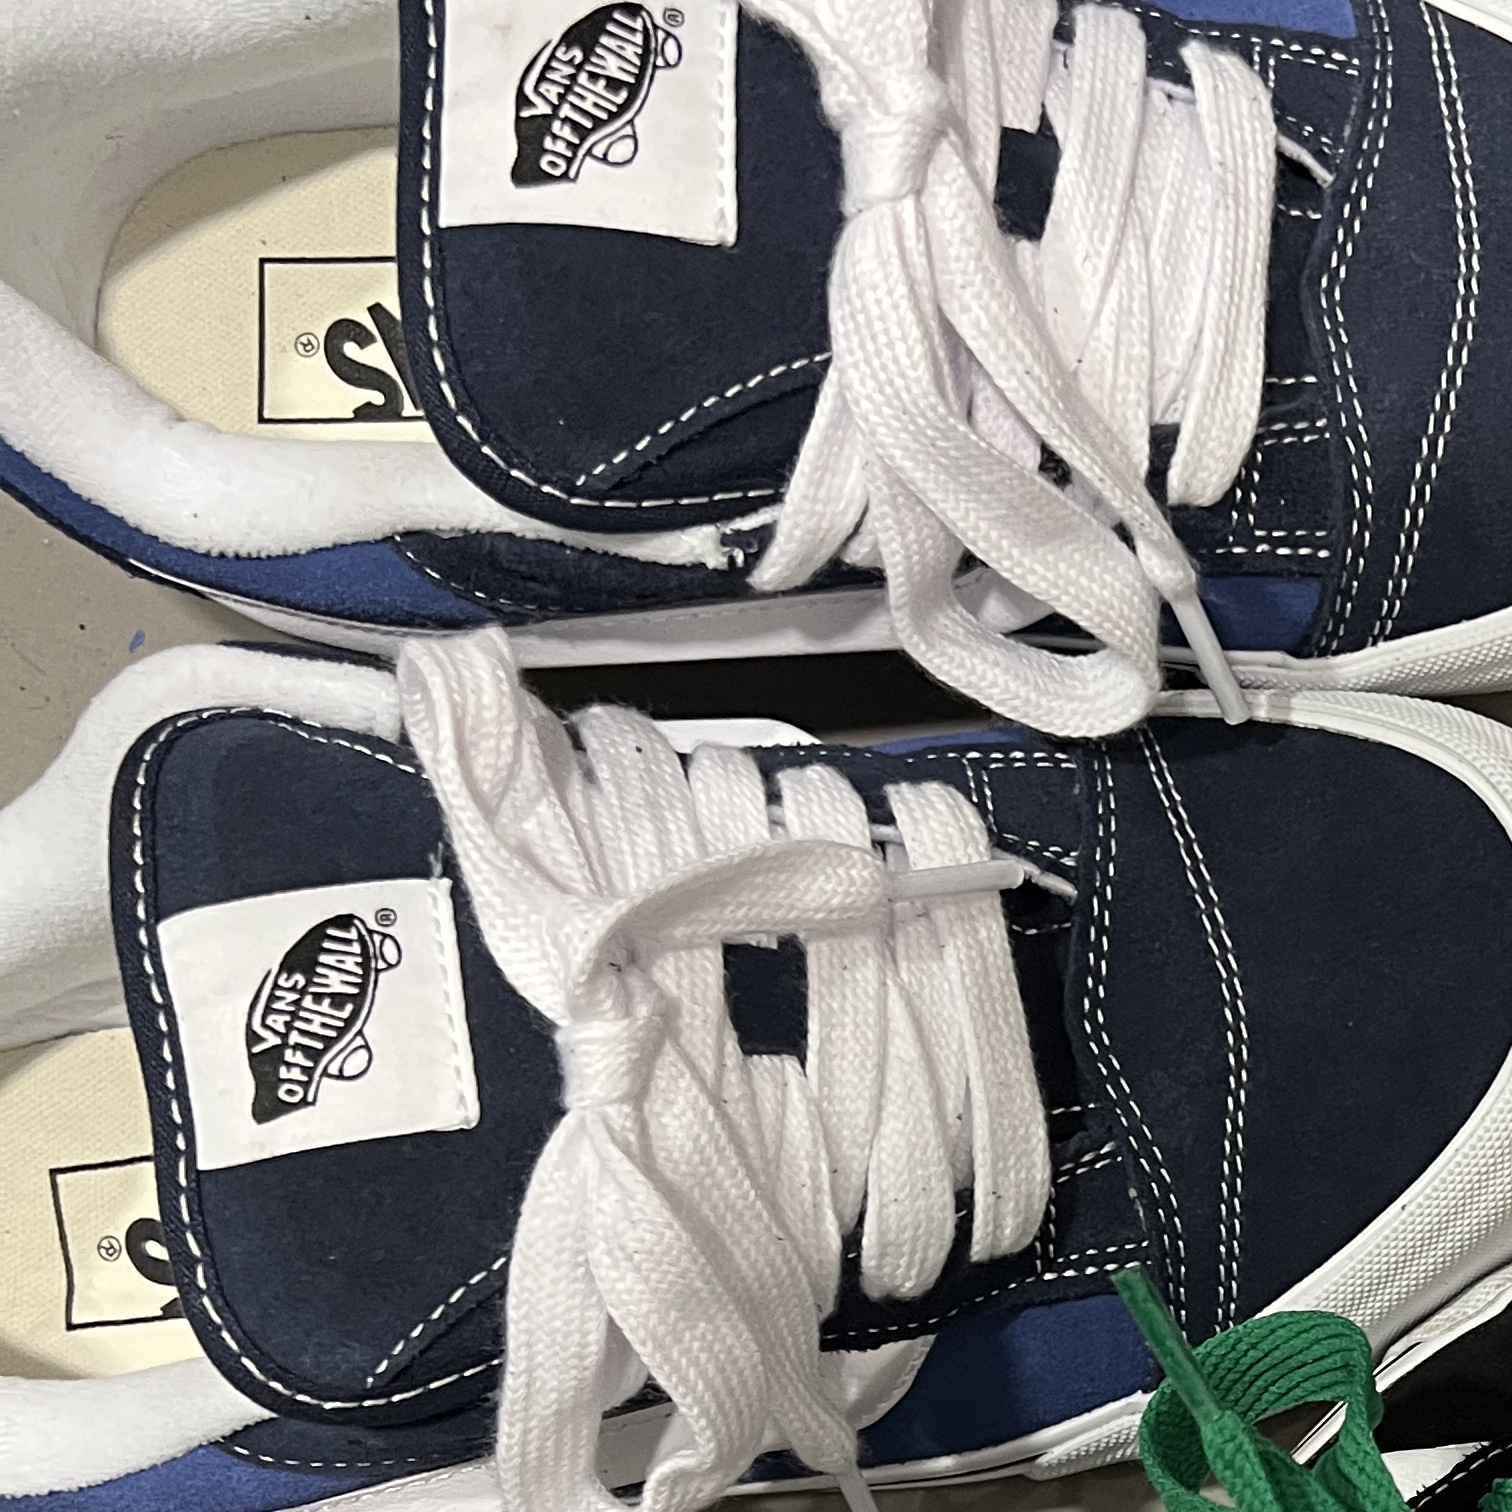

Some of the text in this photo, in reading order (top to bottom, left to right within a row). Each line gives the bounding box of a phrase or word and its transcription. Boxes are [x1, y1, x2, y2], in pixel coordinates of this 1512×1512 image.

[519, 40, 584, 118] VANS
[539, 10, 645, 177] OFF THE WALL
[251, 968, 306, 1053] VANS
[277, 927, 364, 1104] OFF THE WALL
